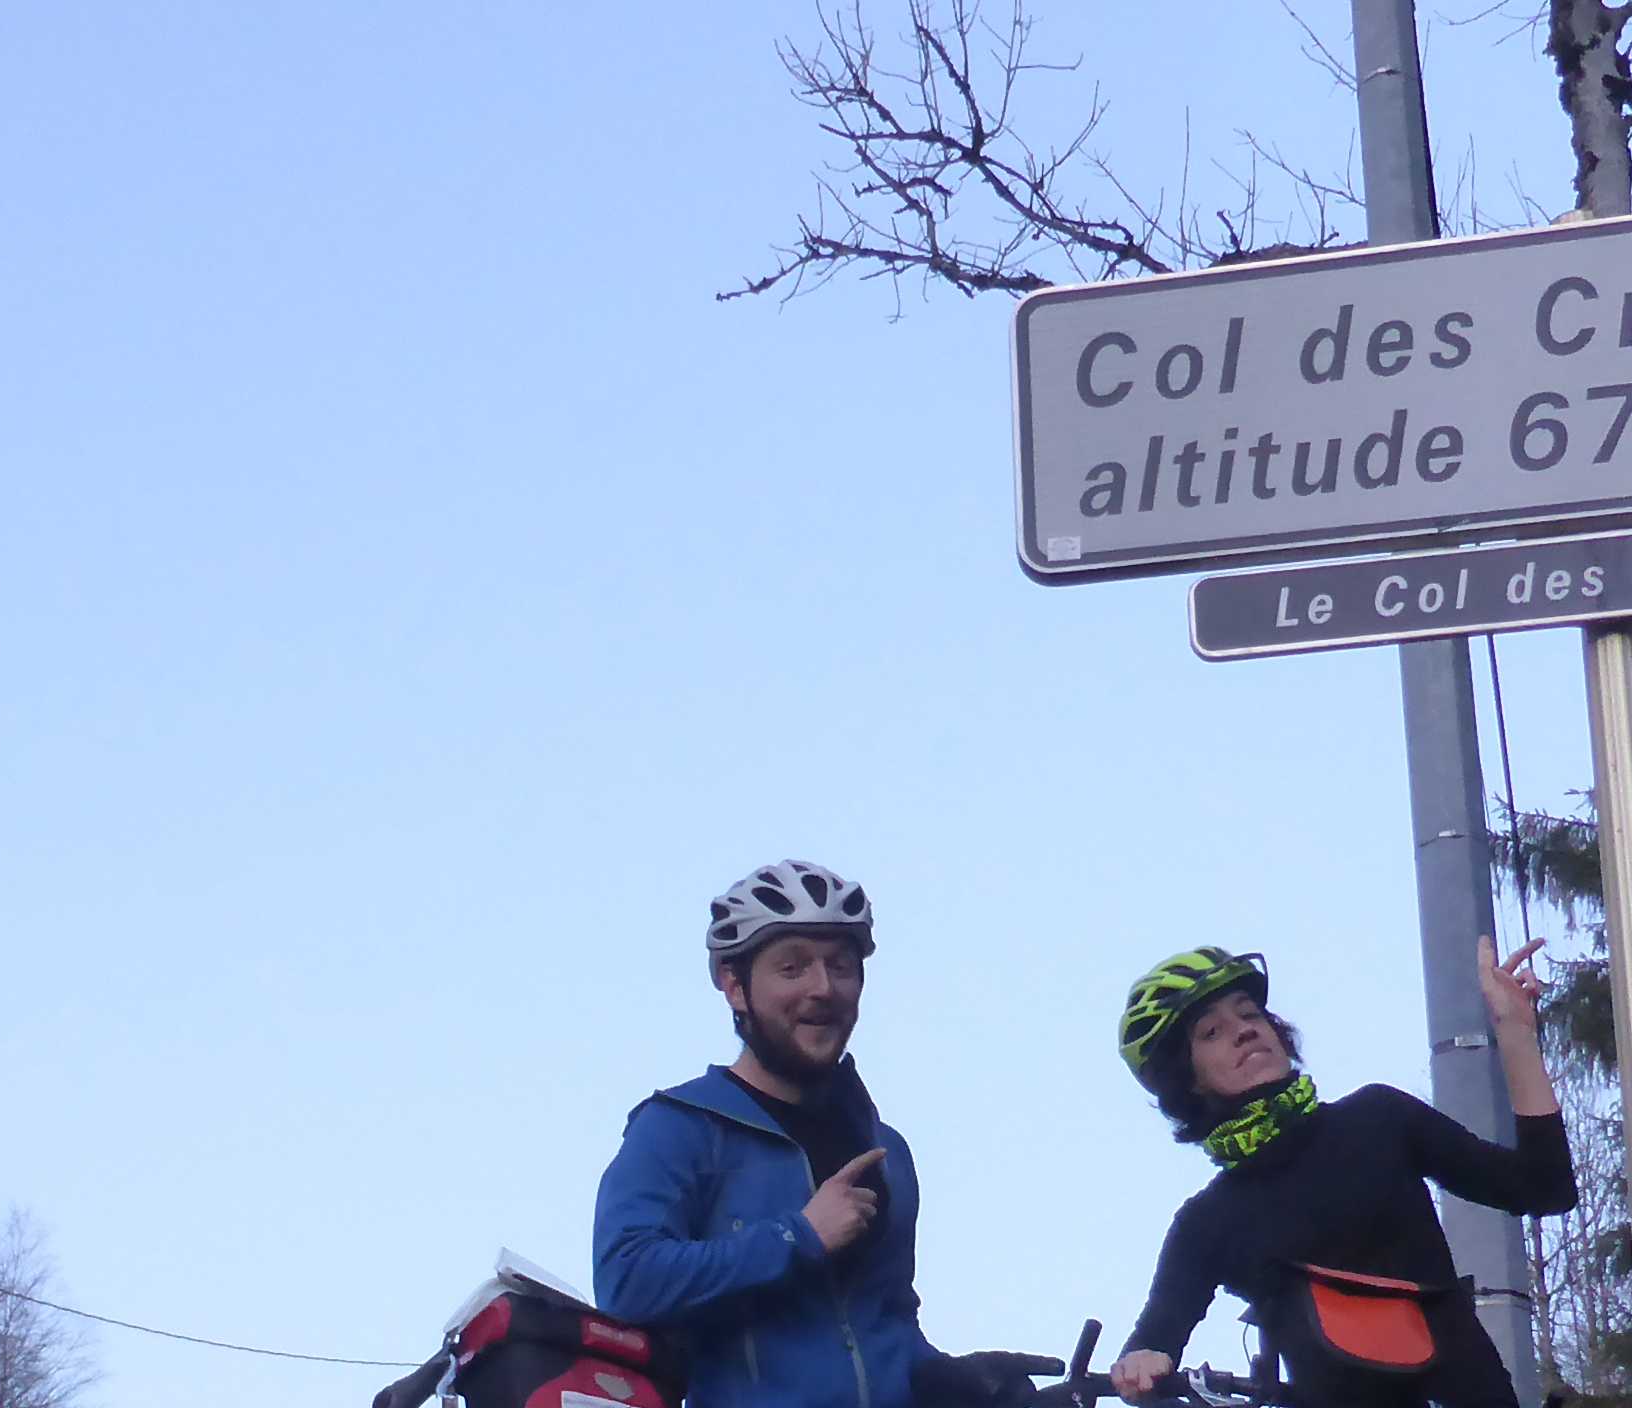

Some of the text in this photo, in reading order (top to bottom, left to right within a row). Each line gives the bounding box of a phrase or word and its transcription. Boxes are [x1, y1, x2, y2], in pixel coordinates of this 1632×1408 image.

[1077, 317, 1244, 407] Col
[1300, 304, 1473, 384] des
[1080, 409, 1463, 517] altitude
[1276, 587, 1332, 627] Le
[1375, 569, 1467, 616] Col
[1507, 562, 1604, 603] des
